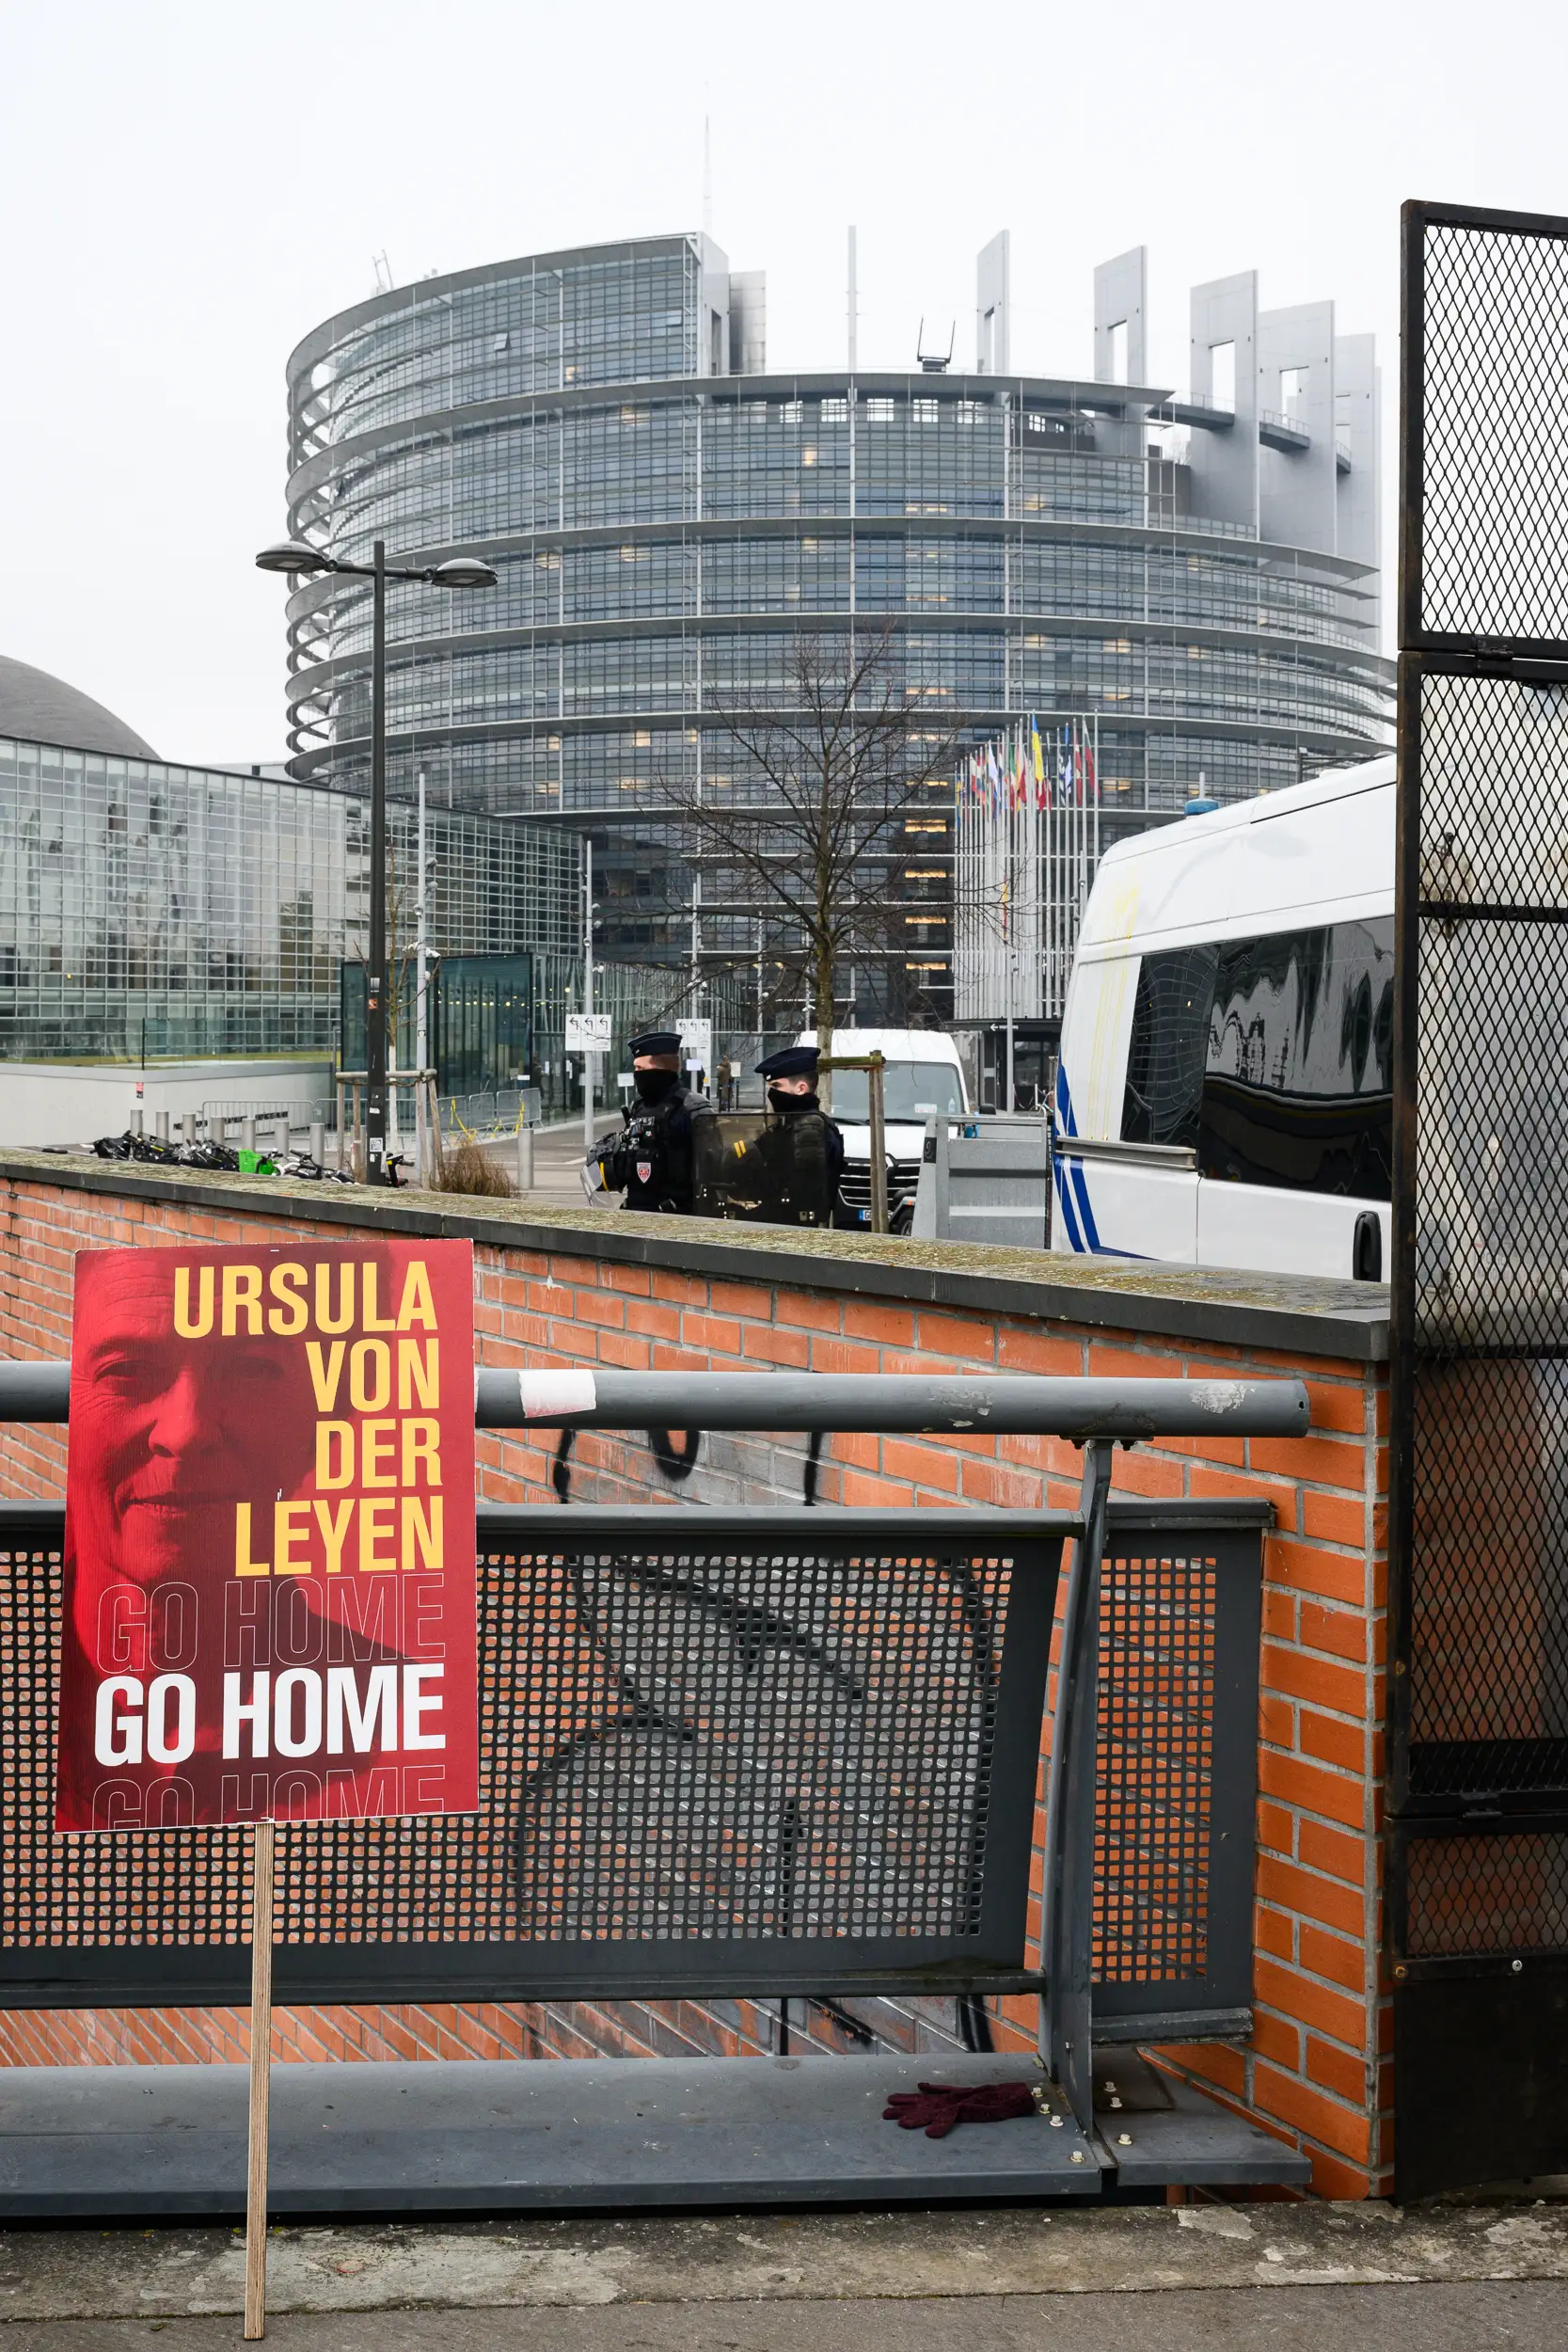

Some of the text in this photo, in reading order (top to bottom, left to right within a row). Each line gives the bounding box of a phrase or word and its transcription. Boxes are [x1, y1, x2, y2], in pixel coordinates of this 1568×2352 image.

[173, 1262, 438, 1338] URSULA
[306, 1338, 440, 1413] VON
[315, 1417, 442, 1490] DER
[234, 1496, 444, 1577] LEYEN
[96, 1573, 447, 1675] GO HOME
[94, 1663, 447, 1767] GO HOME
